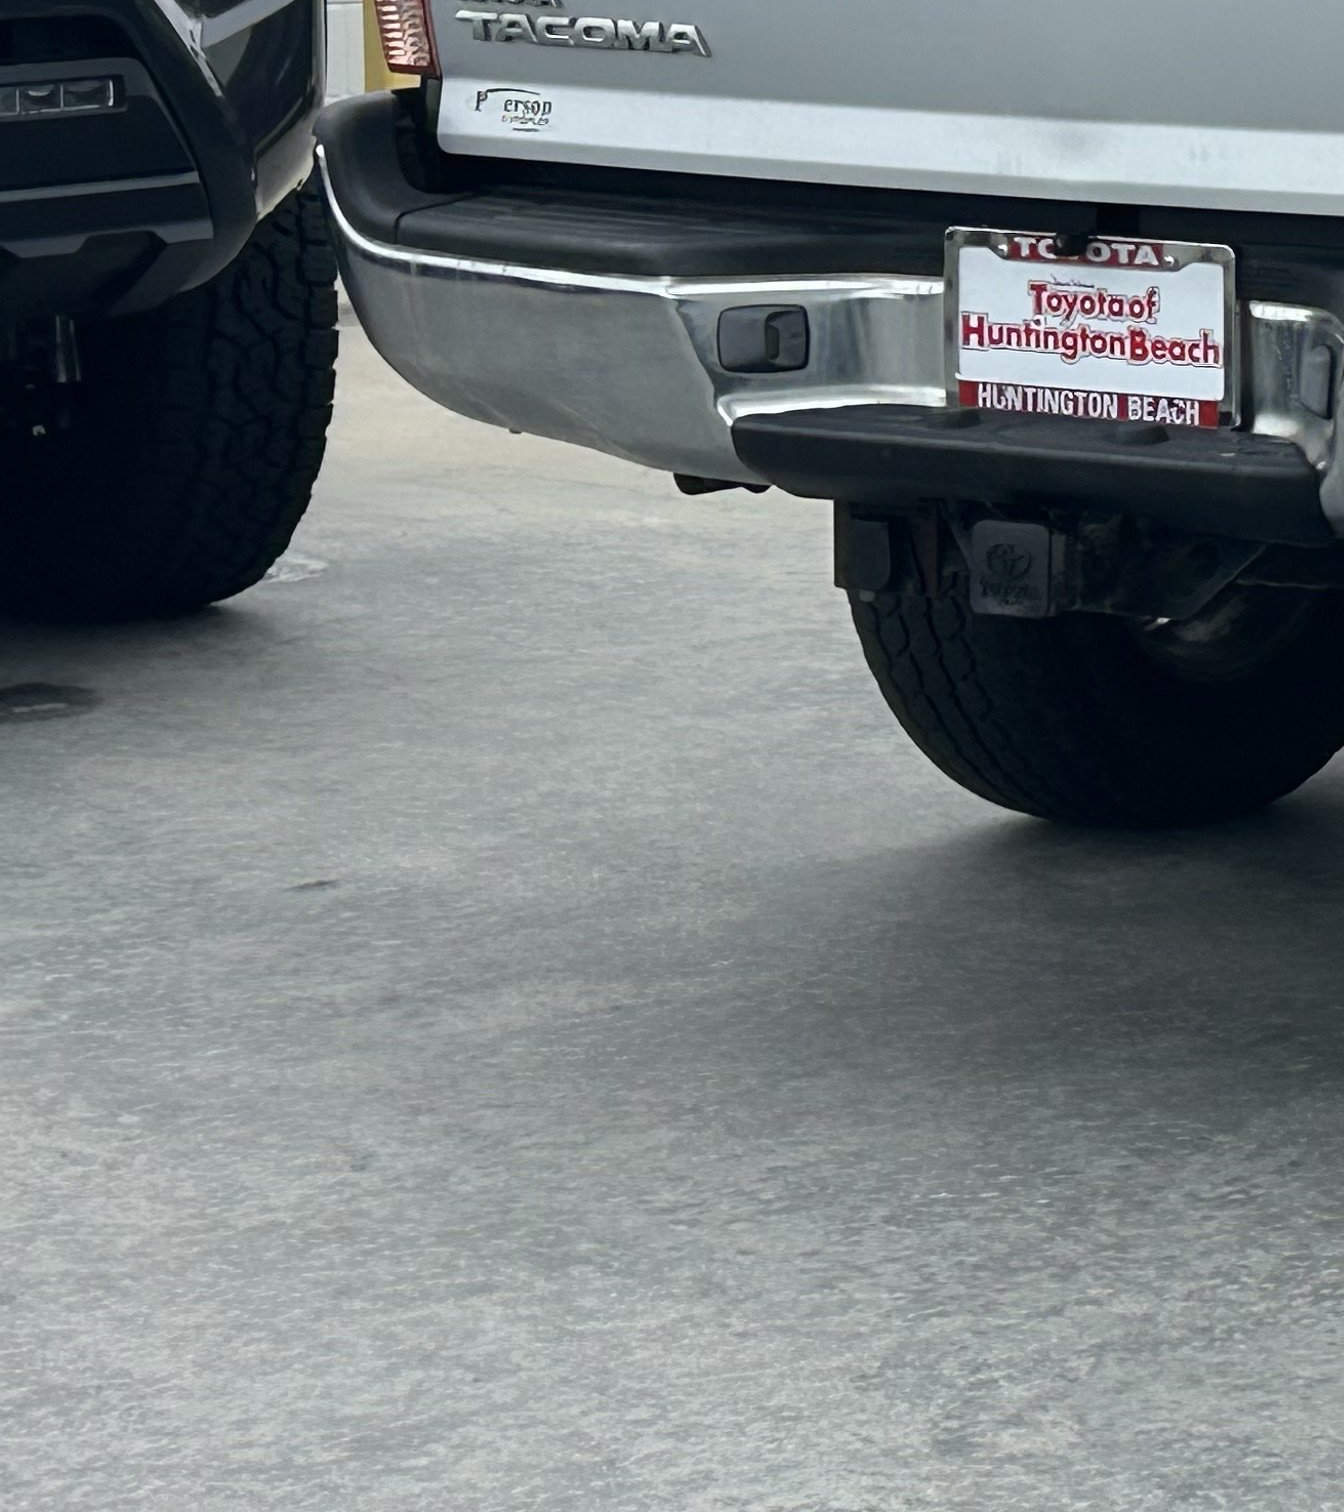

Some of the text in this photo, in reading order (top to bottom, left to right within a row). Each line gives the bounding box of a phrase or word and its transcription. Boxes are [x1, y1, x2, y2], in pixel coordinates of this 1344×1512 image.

[455, 9, 713, 58] TACOMA
[1014, 236, 1160, 267] TOOTA
[1029, 281, 1160, 324] Toyota of
[960, 311, 1222, 367] Huntington Beach
[977, 382, 1200, 426] HUNTINGTON BEACH
